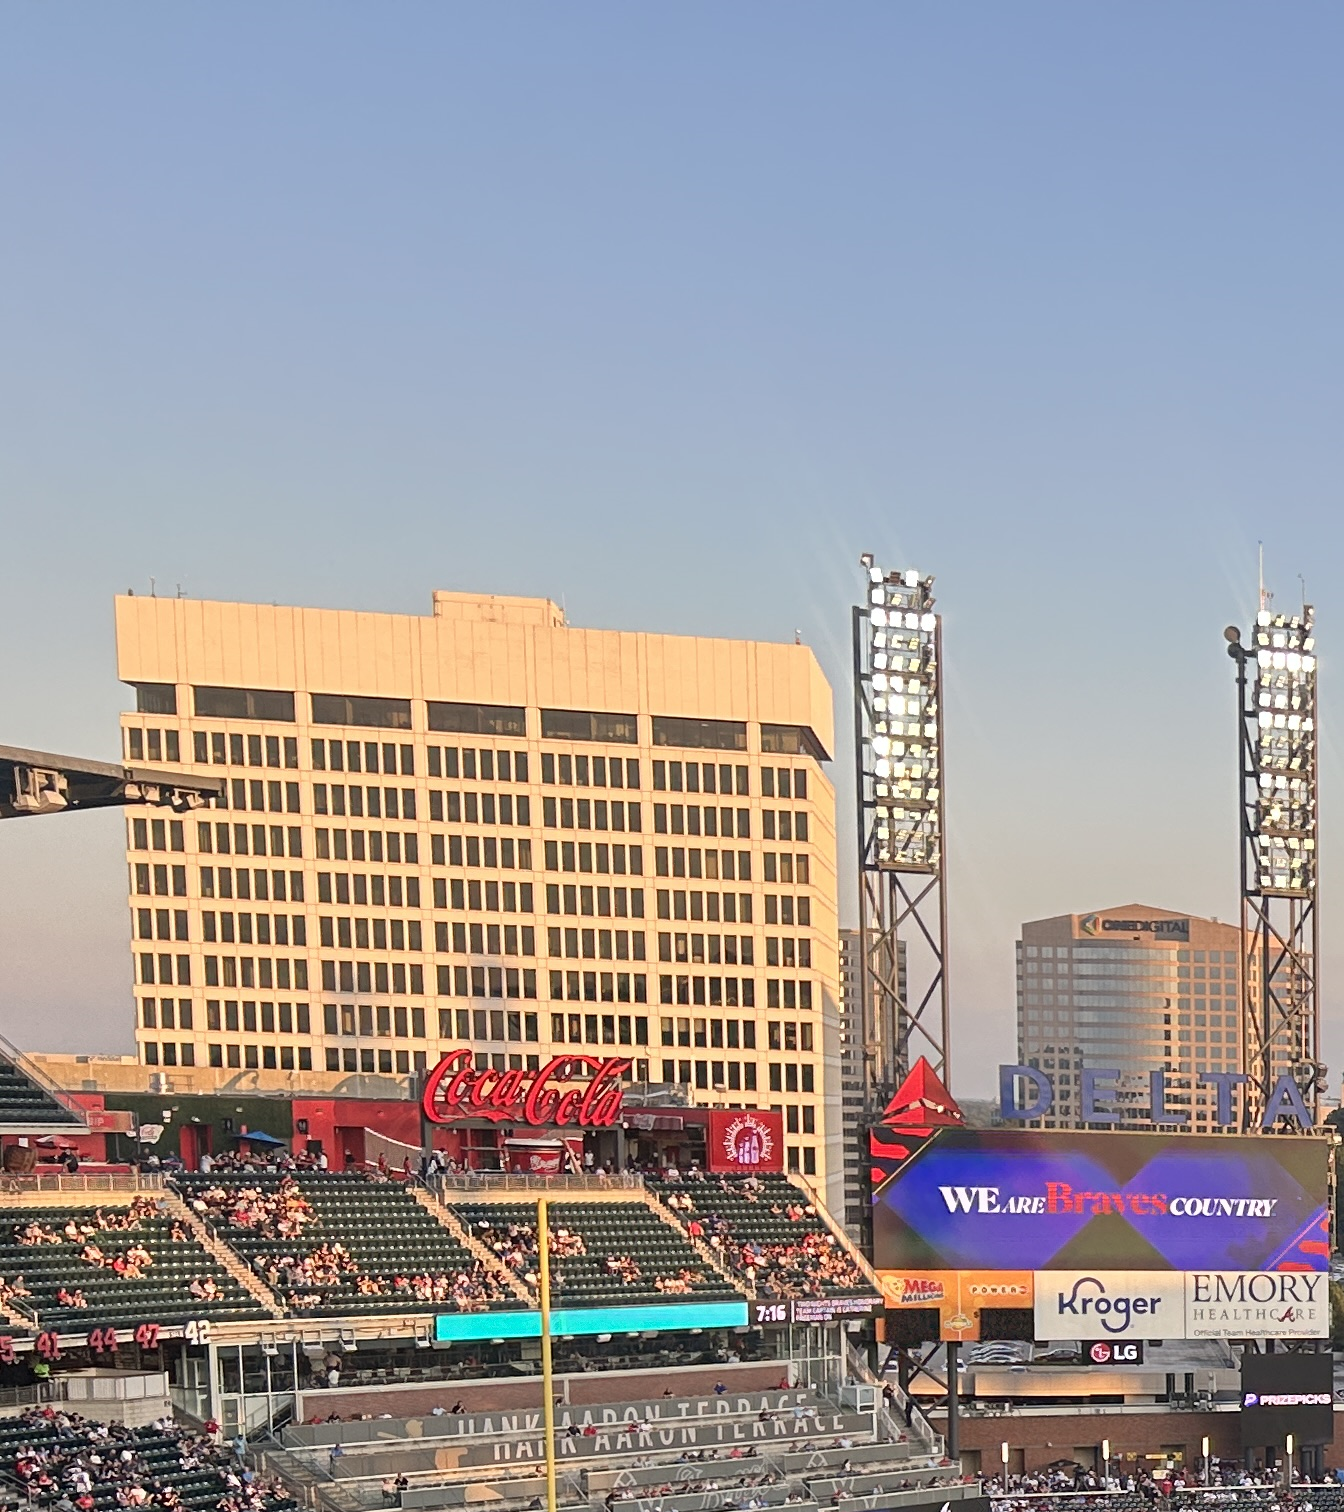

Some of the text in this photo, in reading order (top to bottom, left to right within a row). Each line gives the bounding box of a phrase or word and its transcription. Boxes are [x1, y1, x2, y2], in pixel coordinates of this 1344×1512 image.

[999, 1064, 1313, 1128] DELTA
[939, 1181, 1278, 1218] WE ARE Braves COUNTRY
[904, 1279, 944, 1294] MEGA
[1192, 1274, 1323, 1303] EMORY
[756, 1304, 786, 1322] 7:16
[1058, 1277, 1161, 1333] Kroger
[1193, 1306, 1316, 1324] HEALTHCARE
[37, 1332, 60, 1358] 41
[90, 1327, 118, 1353] 44
[136, 1323, 160, 1349] 47
[185, 1319, 212, 1346] 42
[1113, 1345, 1138, 1361] LG
[1260, 1394, 1332, 1406] PRIZEPICKS
